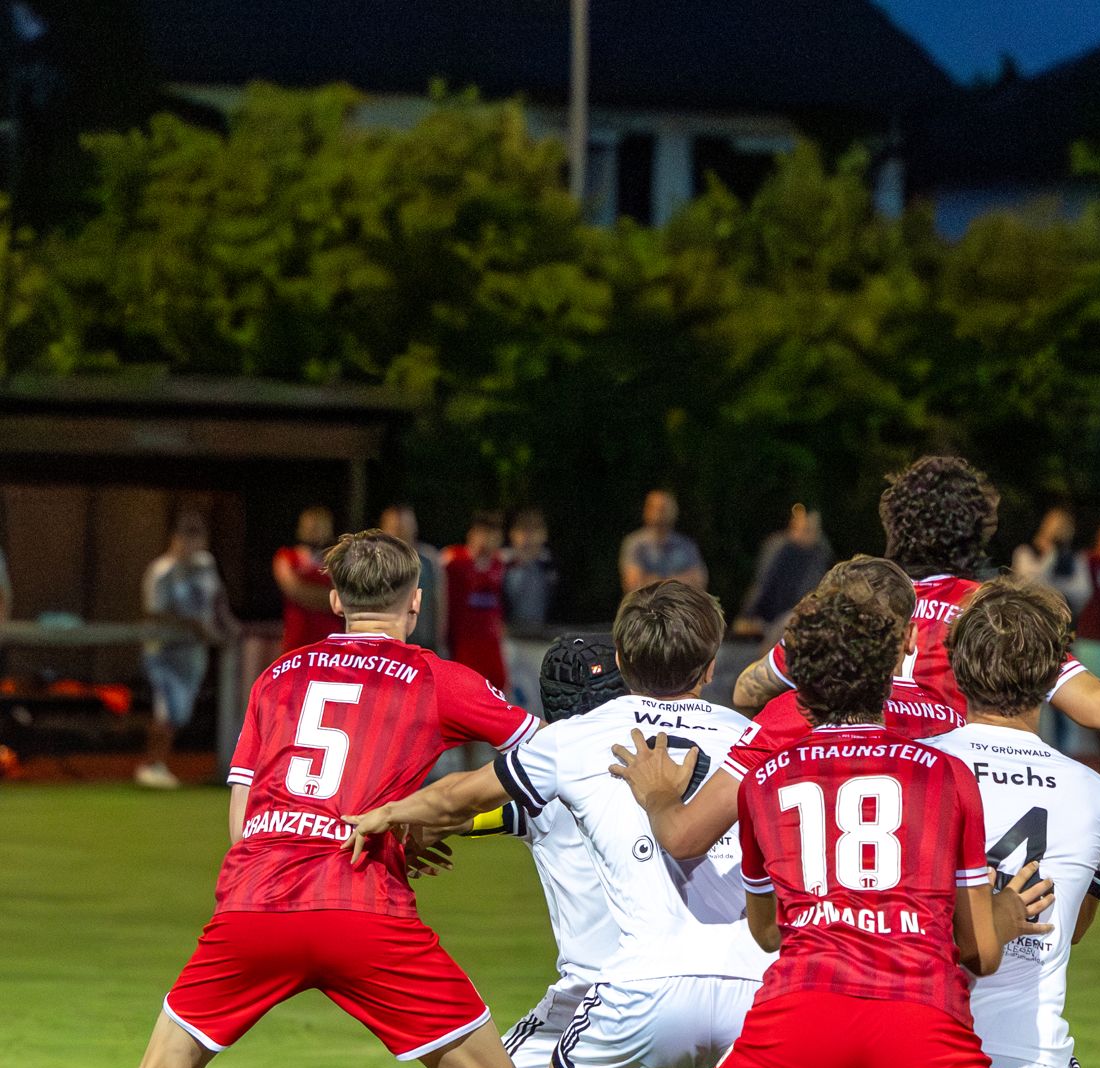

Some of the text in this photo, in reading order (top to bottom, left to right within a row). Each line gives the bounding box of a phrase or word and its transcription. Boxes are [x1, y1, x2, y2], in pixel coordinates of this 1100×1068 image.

[272, 652, 419, 684] SBC TRAUNSTEIN
[658, 702, 712, 713] GRÜNWALD
[285, 680, 364, 800] 5
[970, 742, 1052, 758] TSV GRÜNWALD
[755, 743, 938, 786] SBC TRAUNSTEIN
[973, 762, 1057, 789] Fuchs
[242, 810, 357, 841] KRANZFELD
[777, 774, 903, 897] 18
[900, 911, 927, 935] N.
